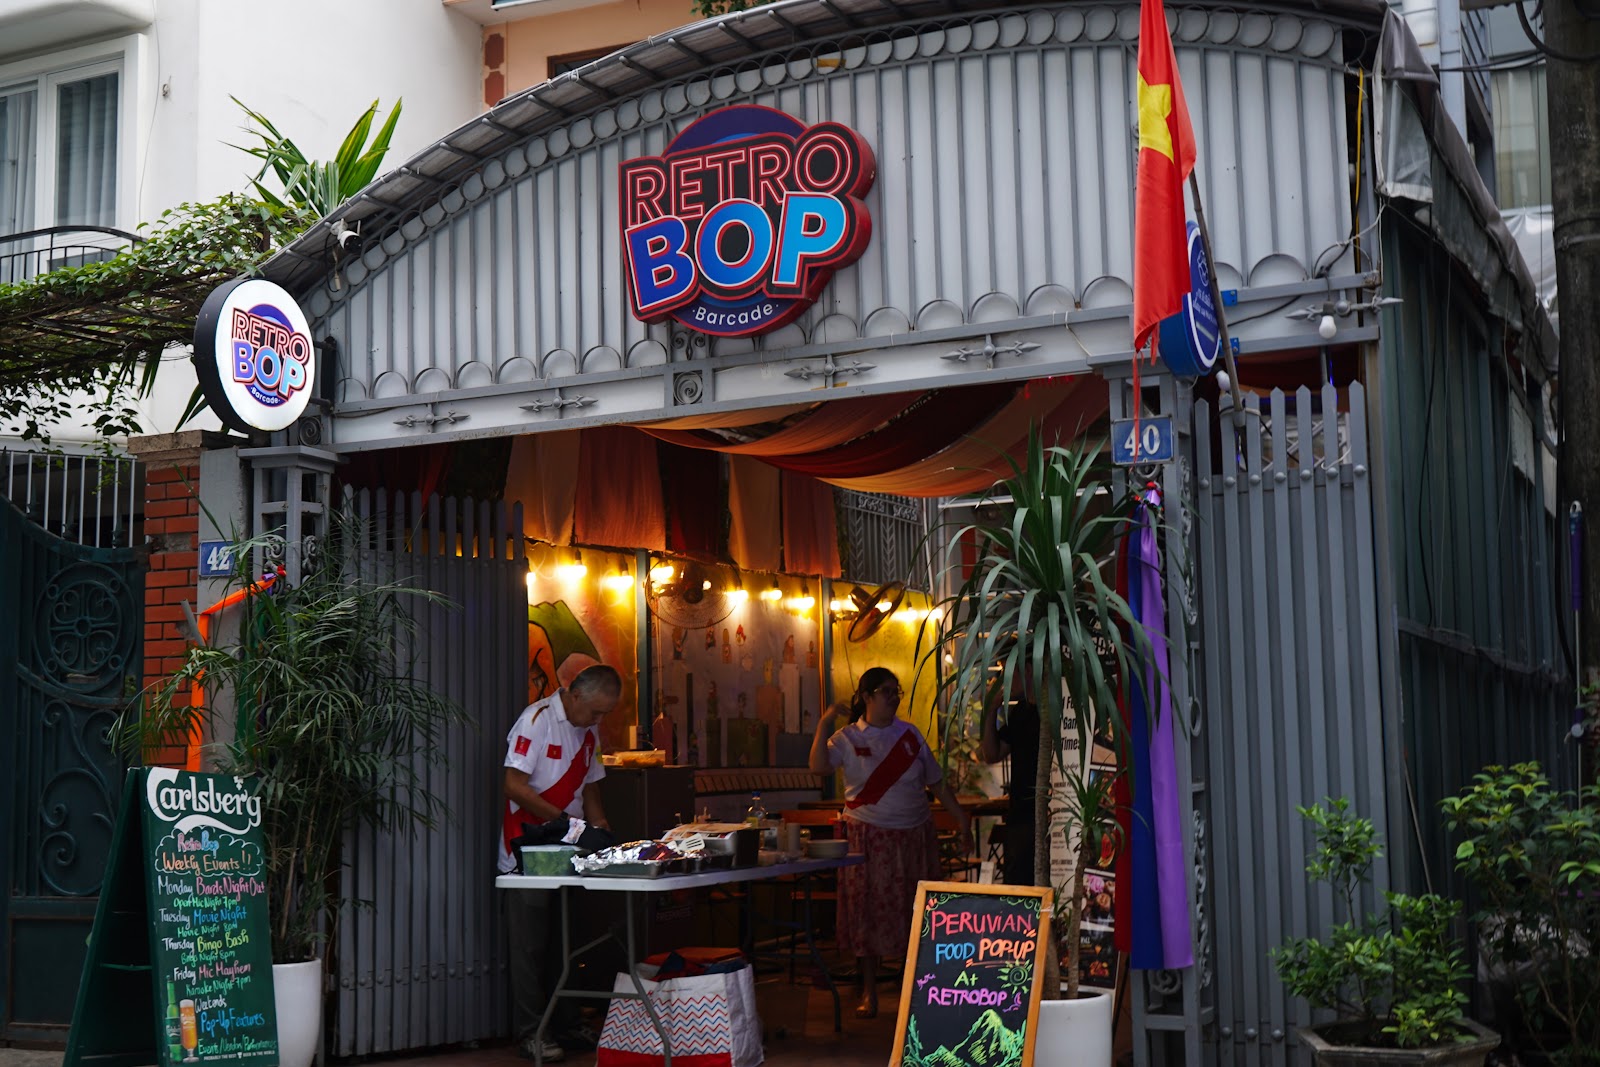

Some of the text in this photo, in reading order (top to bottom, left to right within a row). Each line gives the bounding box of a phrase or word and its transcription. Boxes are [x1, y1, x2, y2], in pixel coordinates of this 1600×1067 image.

[626, 134, 851, 228] RETRO
[625, 191, 846, 310] BOP
[695, 302, 774, 325] Barcade
[233, 310, 309, 364] RETRO
[232, 338, 305, 397] BOP
[252, 387, 279, 404] Barcade
[1124, 424, 1160, 457] 40
[206, 546, 230, 570] 42
[147, 767, 261, 834] Carlsberg
[162, 852, 200, 876] Weekly
[157, 875, 194, 903] Monday
[196, 876, 223, 895] Bards
[223, 875, 250, 901] Night
[159, 906, 247, 930] Tuesday Movie Night
[177, 926, 199, 938] Movie
[201, 923, 219, 937] Night
[197, 936, 222, 955] Bingo
[225, 929, 249, 948] Bash
[935, 942, 976, 964] FOOD
[173, 960, 251, 986] Friday Mic Mayhem
[927, 985, 1008, 1007] RETROBOP
